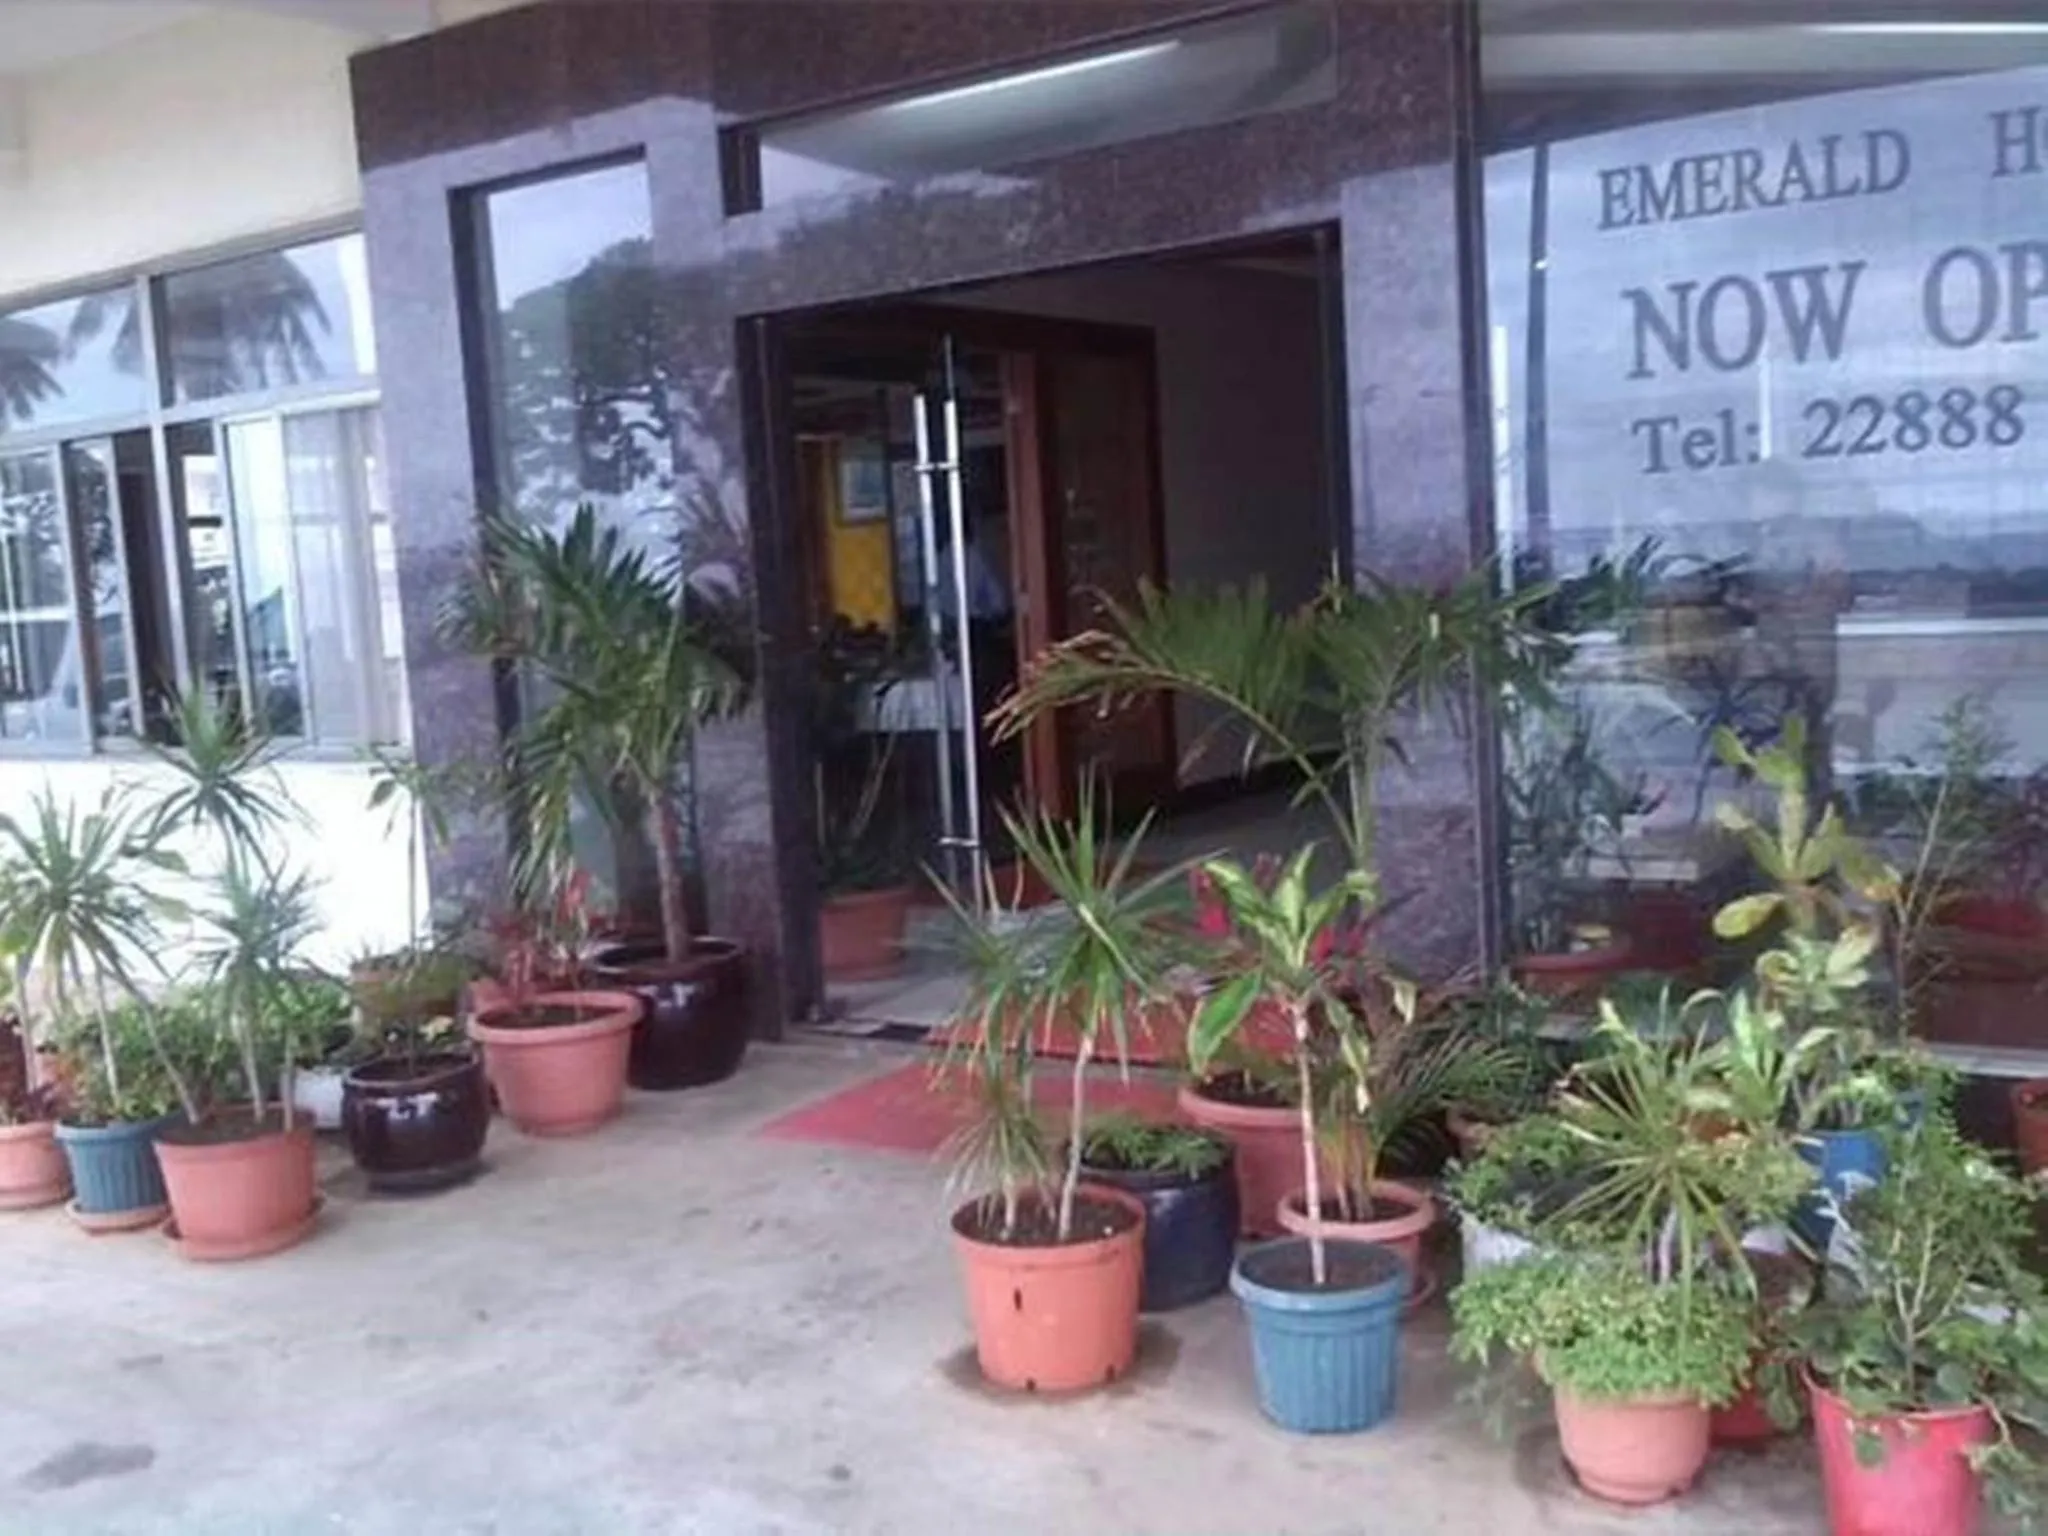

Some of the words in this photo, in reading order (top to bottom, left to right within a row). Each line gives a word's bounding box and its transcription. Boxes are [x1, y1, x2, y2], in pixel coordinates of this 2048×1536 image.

[1596, 129, 1911, 231] EMERALD
[1989, 106, 2048, 179] H
[1620, 260, 1868, 381] NOW
[1631, 408, 1763, 475] Tel:
[1801, 384, 2025, 459] 22888
